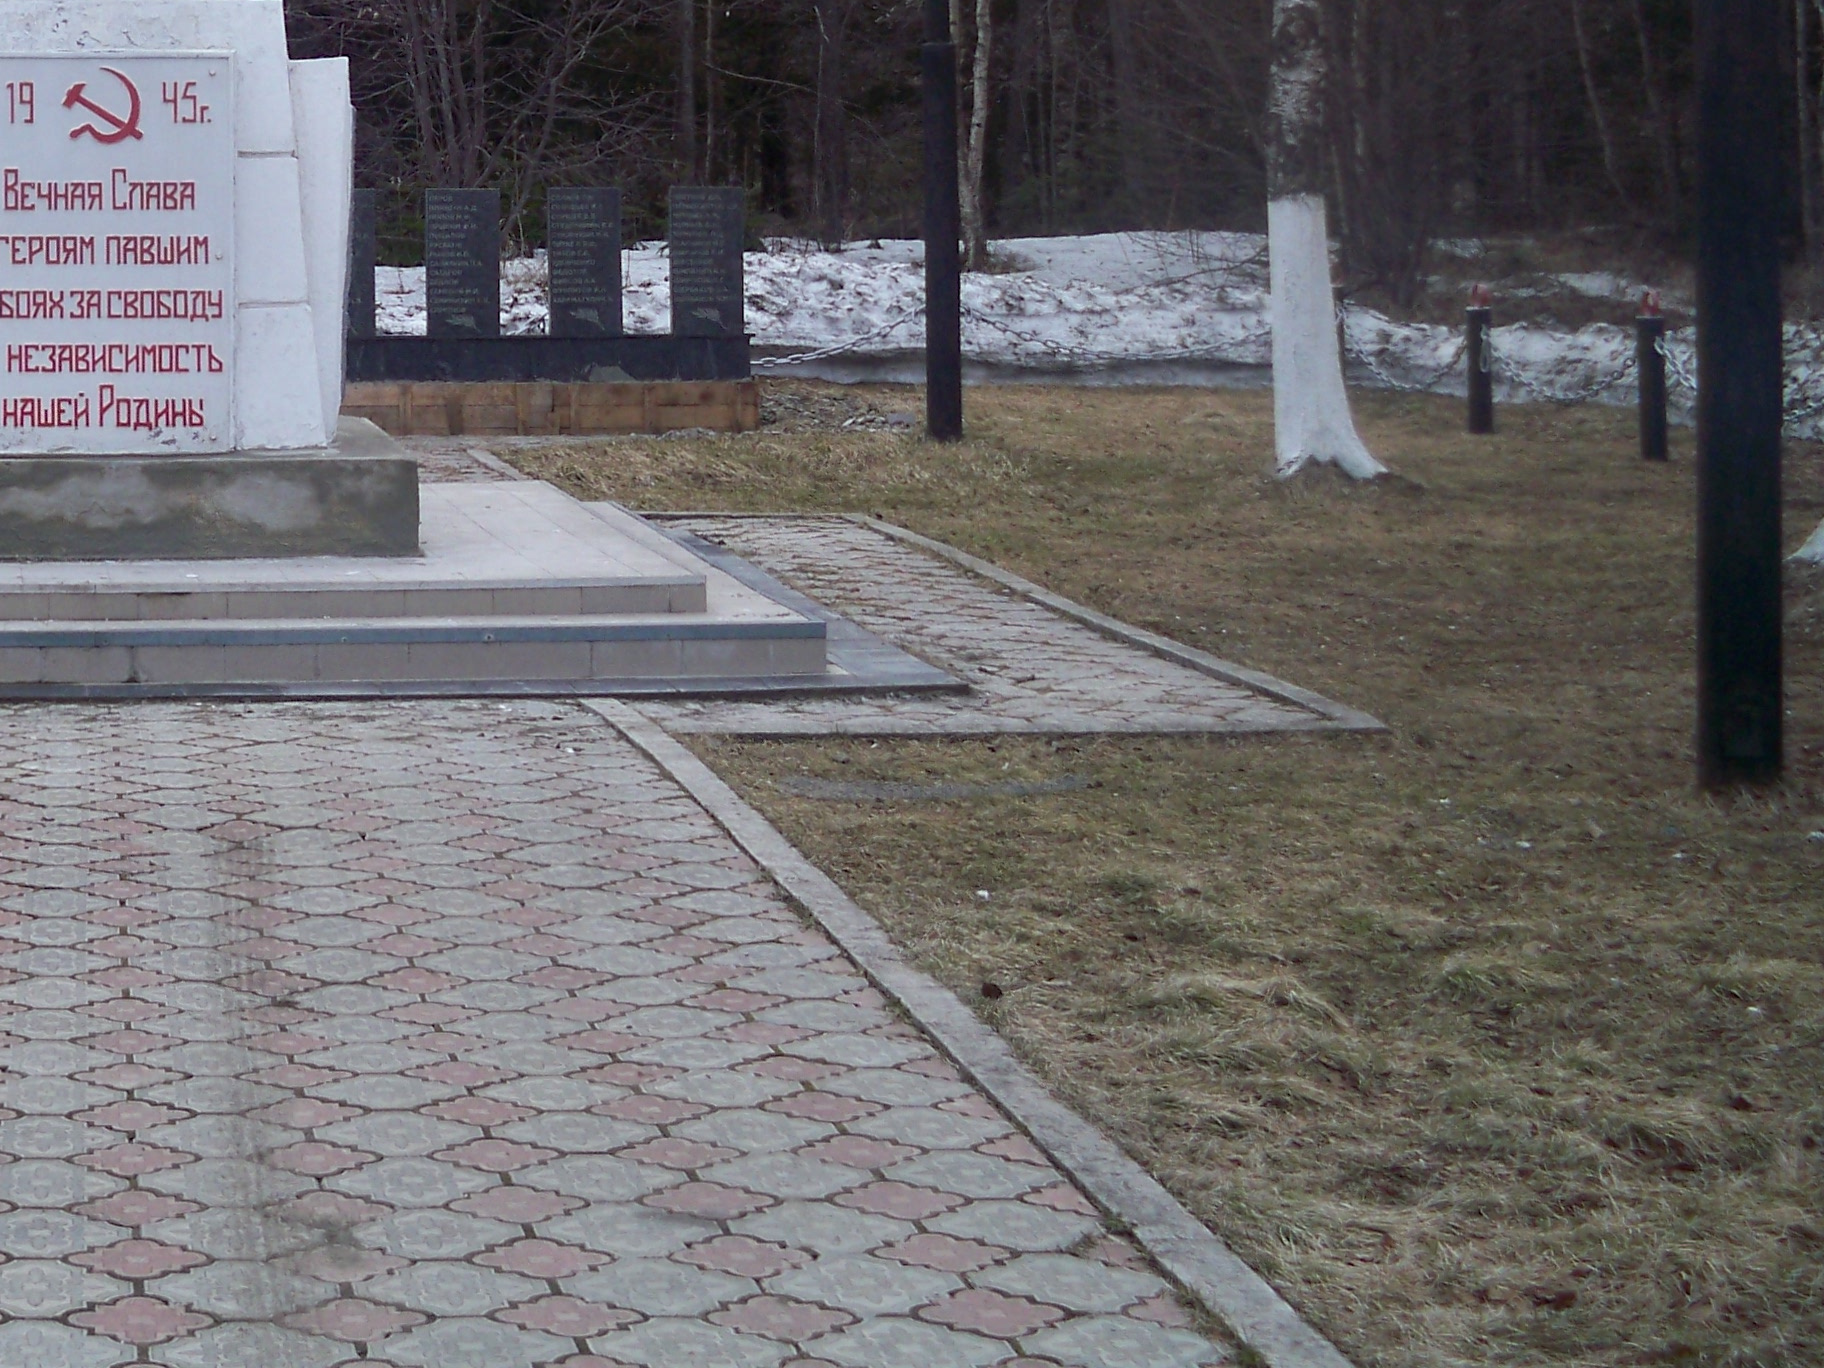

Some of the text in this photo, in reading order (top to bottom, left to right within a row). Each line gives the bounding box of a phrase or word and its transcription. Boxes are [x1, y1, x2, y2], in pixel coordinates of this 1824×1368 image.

[5, 81, 35, 124] 19
[3, 168, 196, 211] ВЕЧНАЯ СЛАВА
[105, 236, 210, 265] ПАВШИМ
[0, 290, 64, 319] БОЯХ
[70, 290, 101, 319] ЗА
[107, 290, 223, 322] СВОБОДУ
[7, 344, 224, 373] НЕЗАВИСИМОСТЬ
[2, 384, 204, 431] НАШЕЙ РОДИНЫ
